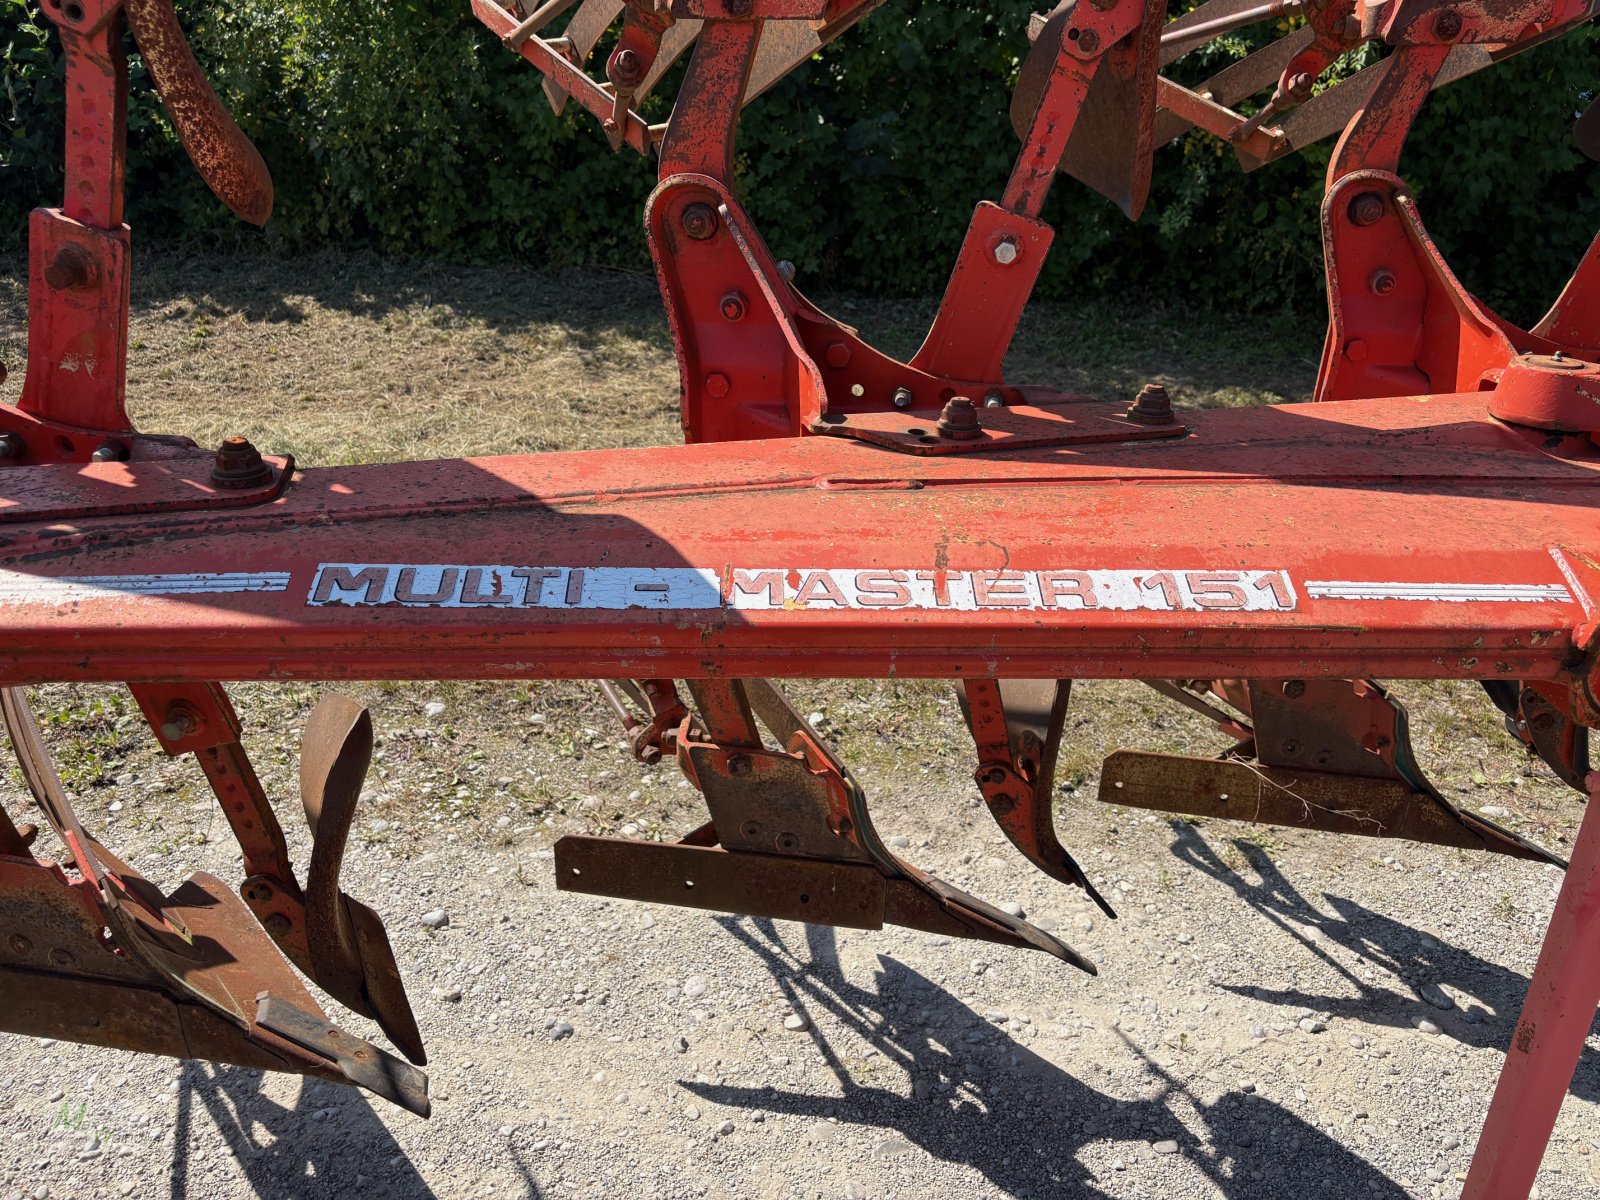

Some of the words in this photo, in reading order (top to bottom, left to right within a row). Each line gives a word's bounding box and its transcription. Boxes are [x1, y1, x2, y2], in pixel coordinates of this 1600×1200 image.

[312, 566, 585, 604] MULTI
[634, 583, 670, 592] -
[720, 571, 1098, 607] MASTER
[1143, 572, 1293, 608] 151
